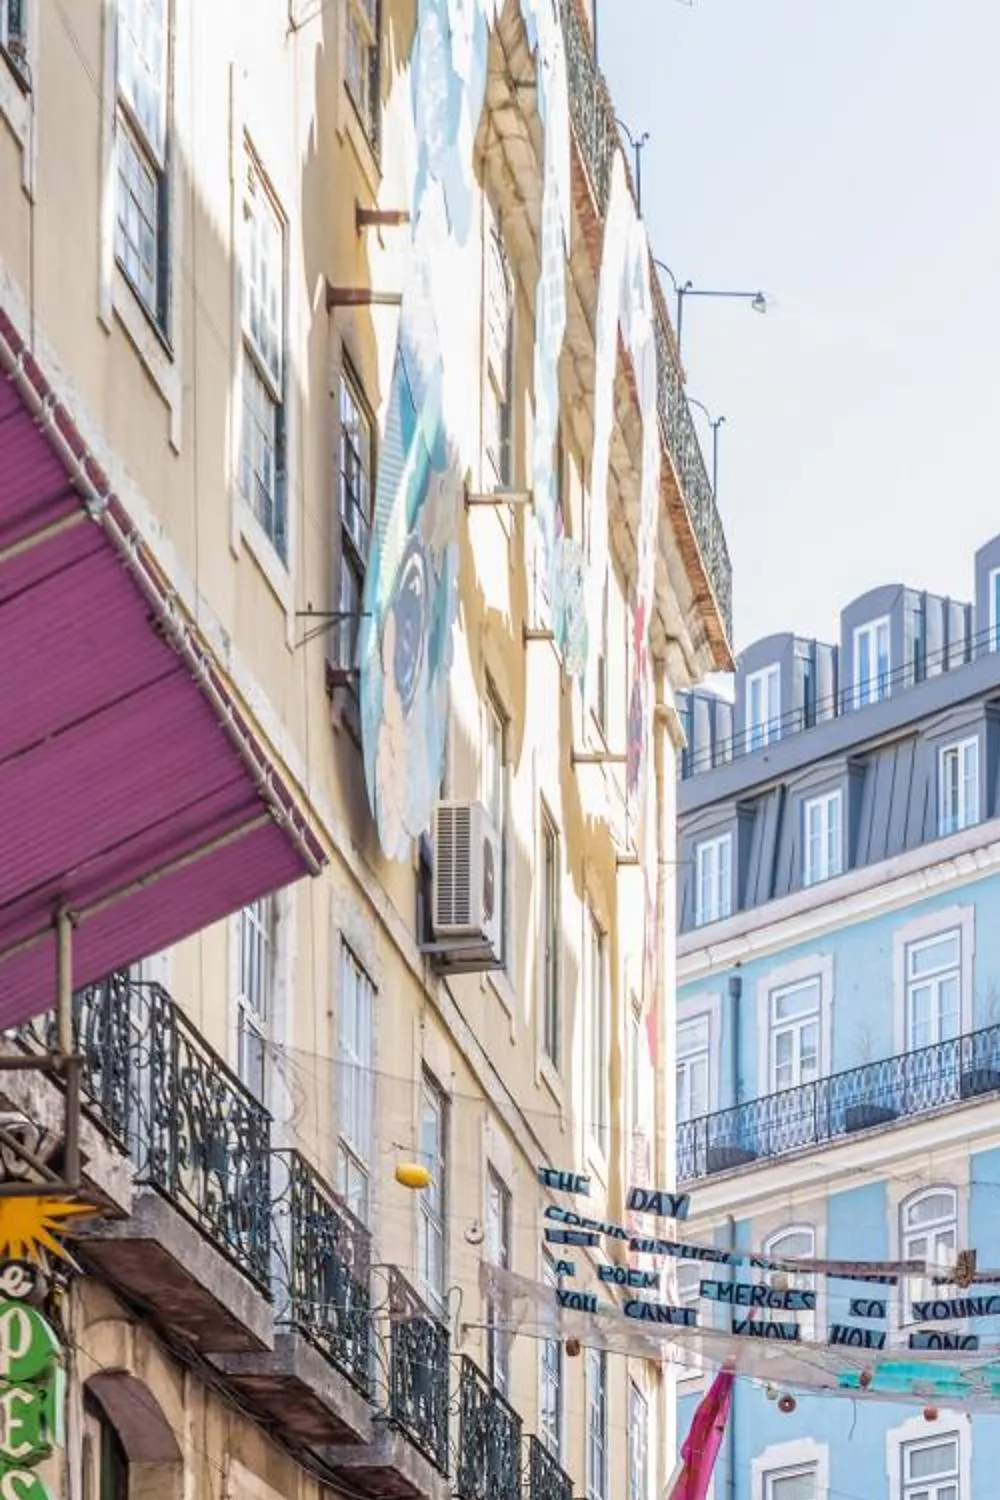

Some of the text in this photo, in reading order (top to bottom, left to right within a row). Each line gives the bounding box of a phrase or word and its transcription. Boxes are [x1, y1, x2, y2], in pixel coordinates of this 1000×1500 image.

[539, 1167, 590, 1195] THE
[628, 1187, 689, 1219] DAY
[556, 1260, 573, 1276] A
[599, 1264, 660, 1289] POEM
[700, 1280, 816, 1310] EMERGES
[849, 1299, 886, 1318] SO
[556, 1289, 597, 1313] YOU
[624, 1301, 696, 1326] CAN'T
[730, 1319, 799, 1340] KNOW
[831, 1324, 886, 1349] HOW
